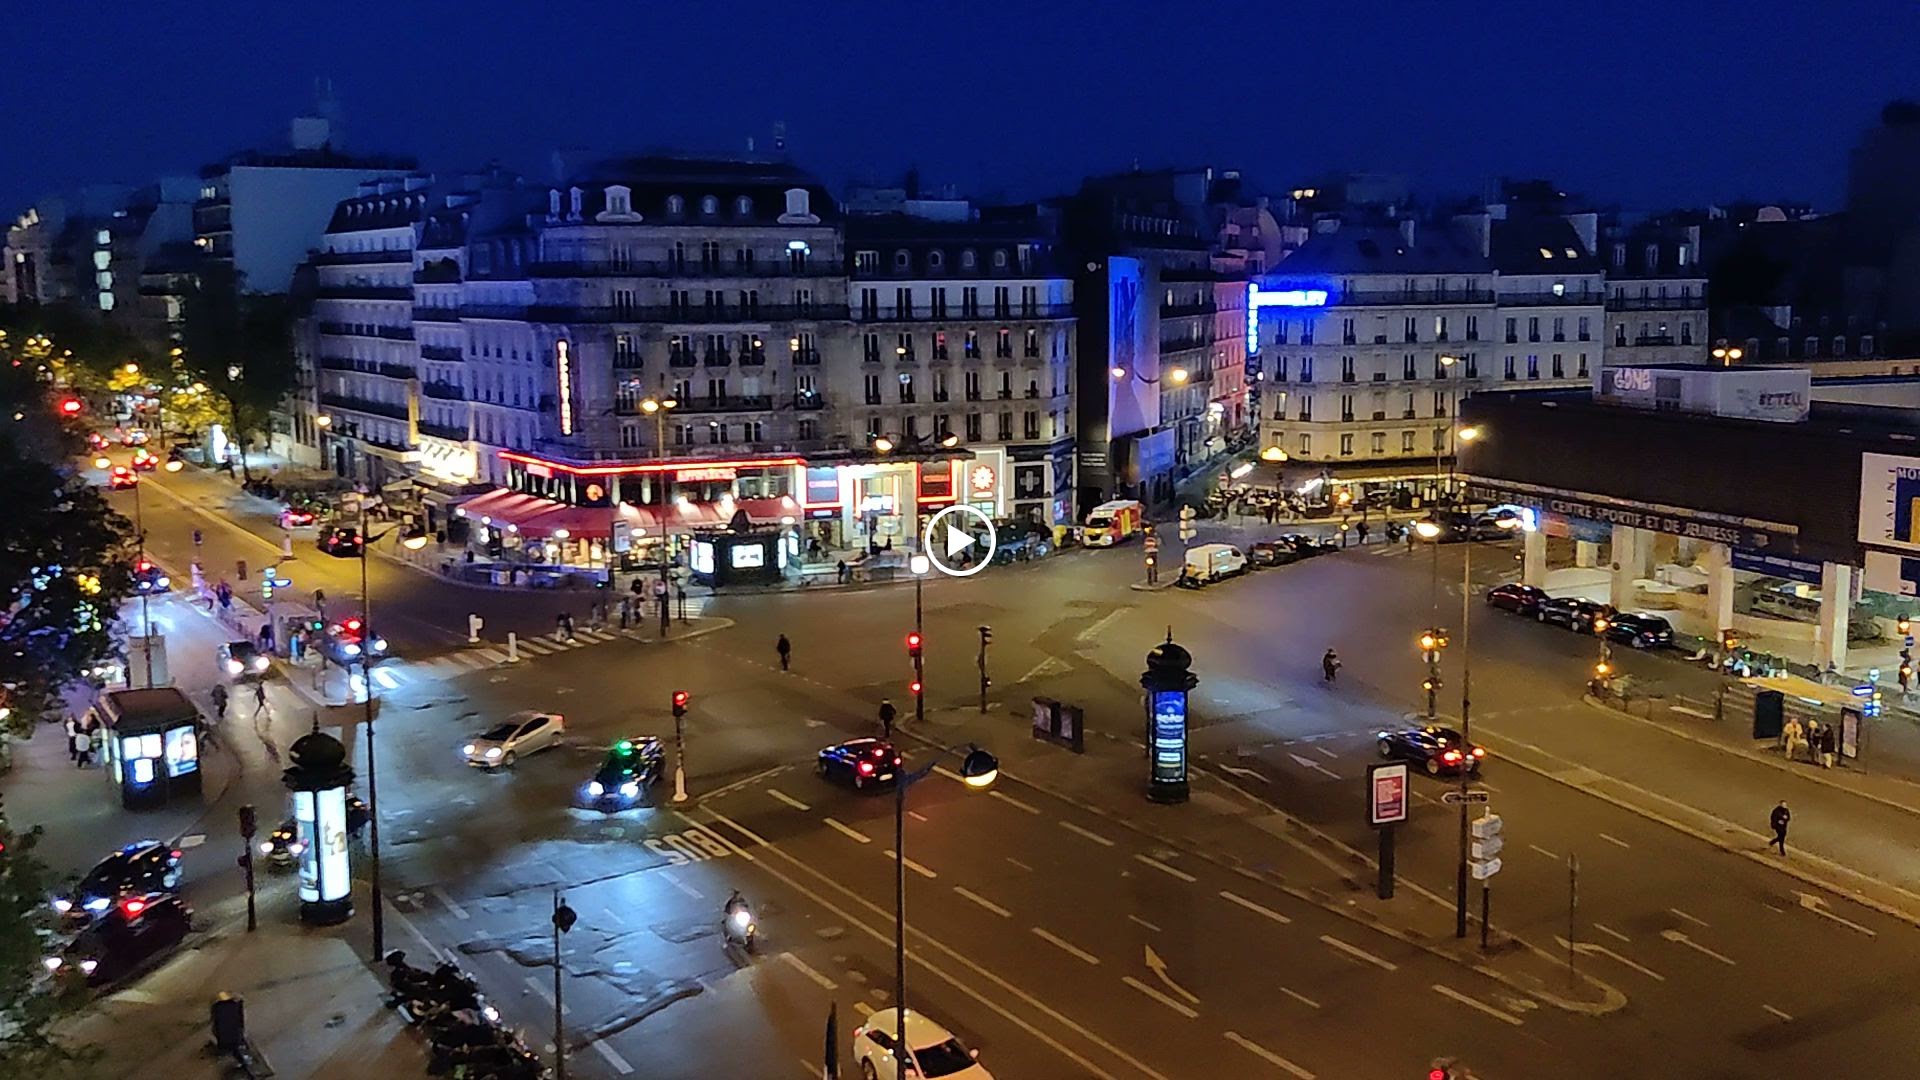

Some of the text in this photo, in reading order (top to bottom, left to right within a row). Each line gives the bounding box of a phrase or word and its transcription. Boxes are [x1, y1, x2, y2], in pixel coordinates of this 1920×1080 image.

[1551, 500, 1592, 518] CENTRE
[1595, 507, 1641, 528] SPORTIF
[1646, 515, 1661, 530] ET
[1663, 518, 1680, 533] DE
[1683, 522, 1741, 544] JEUNESSE
[643, 829, 732, 865] BUS
